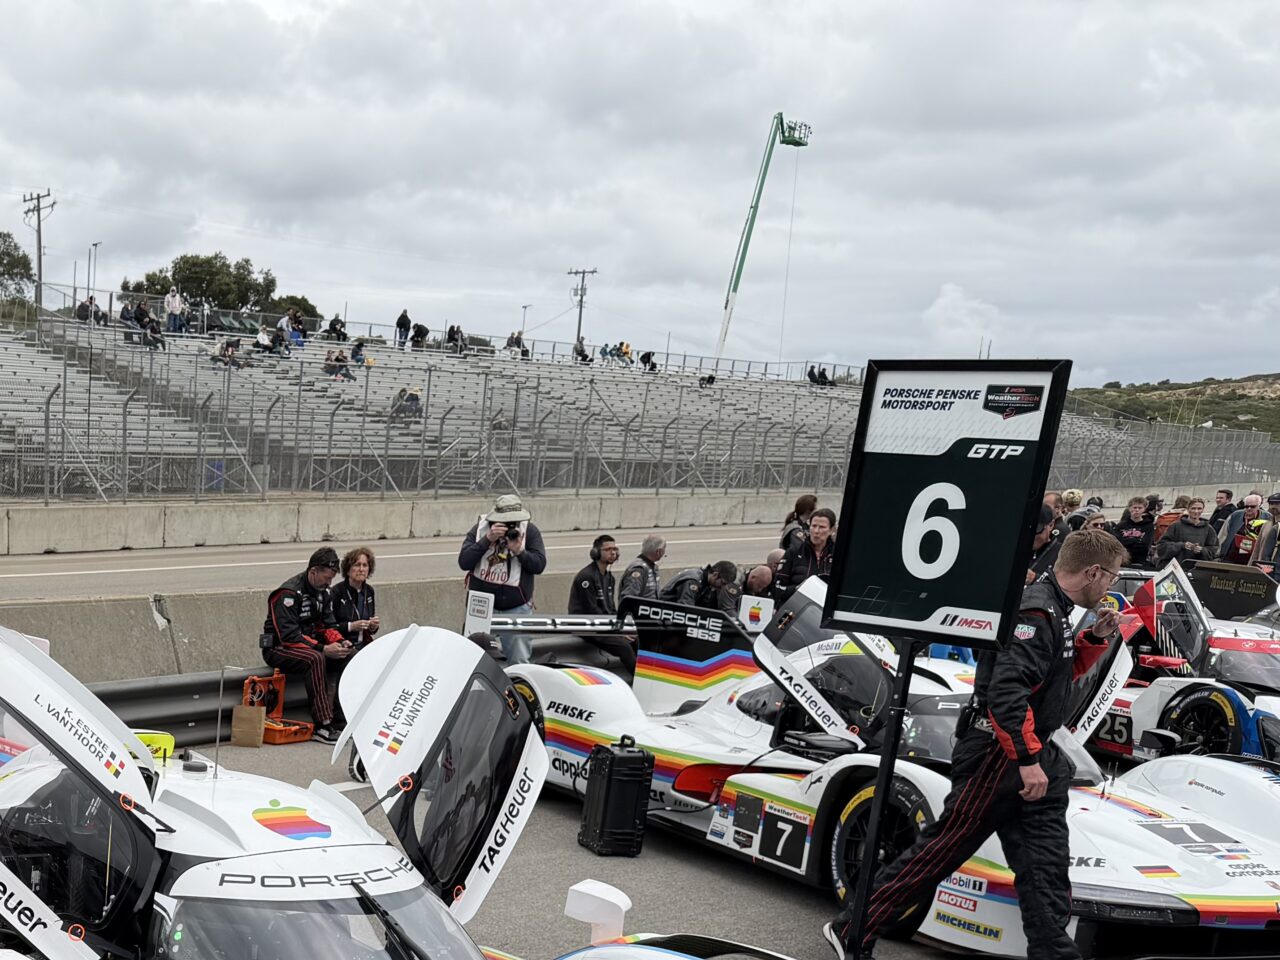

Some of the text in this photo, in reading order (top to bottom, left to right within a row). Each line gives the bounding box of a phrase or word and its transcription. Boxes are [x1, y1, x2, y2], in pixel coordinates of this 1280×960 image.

[880, 399, 955, 411] MOTORSPORT
[883, 388, 982, 400] PORSCHE PENSKE
[987, 394, 1040, 402] WeatherTech
[967, 443, 1025, 460] GTP
[902, 482, 967, 580] 6
[638, 605, 723, 631] PORSCHE
[956, 618, 993, 631] IMSA
[686, 627, 721, 643] 963
[388, 688, 414, 719] ESTRE
[401, 675, 438, 728] VANTHOOR
[546, 700, 597, 723] PENSKE
[46, 703, 105, 762] VANTHOOR
[76, 718, 110, 754] ESTRE
[1098, 714, 1128, 743] 25
[767, 804, 809, 822] WeatherTech
[776, 821, 793, 856] 7
[1161, 823, 1205, 842] 7
[219, 856, 415, 888] PORSCHE
[939, 893, 975, 911] MOTUL
[936, 911, 999, 938] MICHELIN
